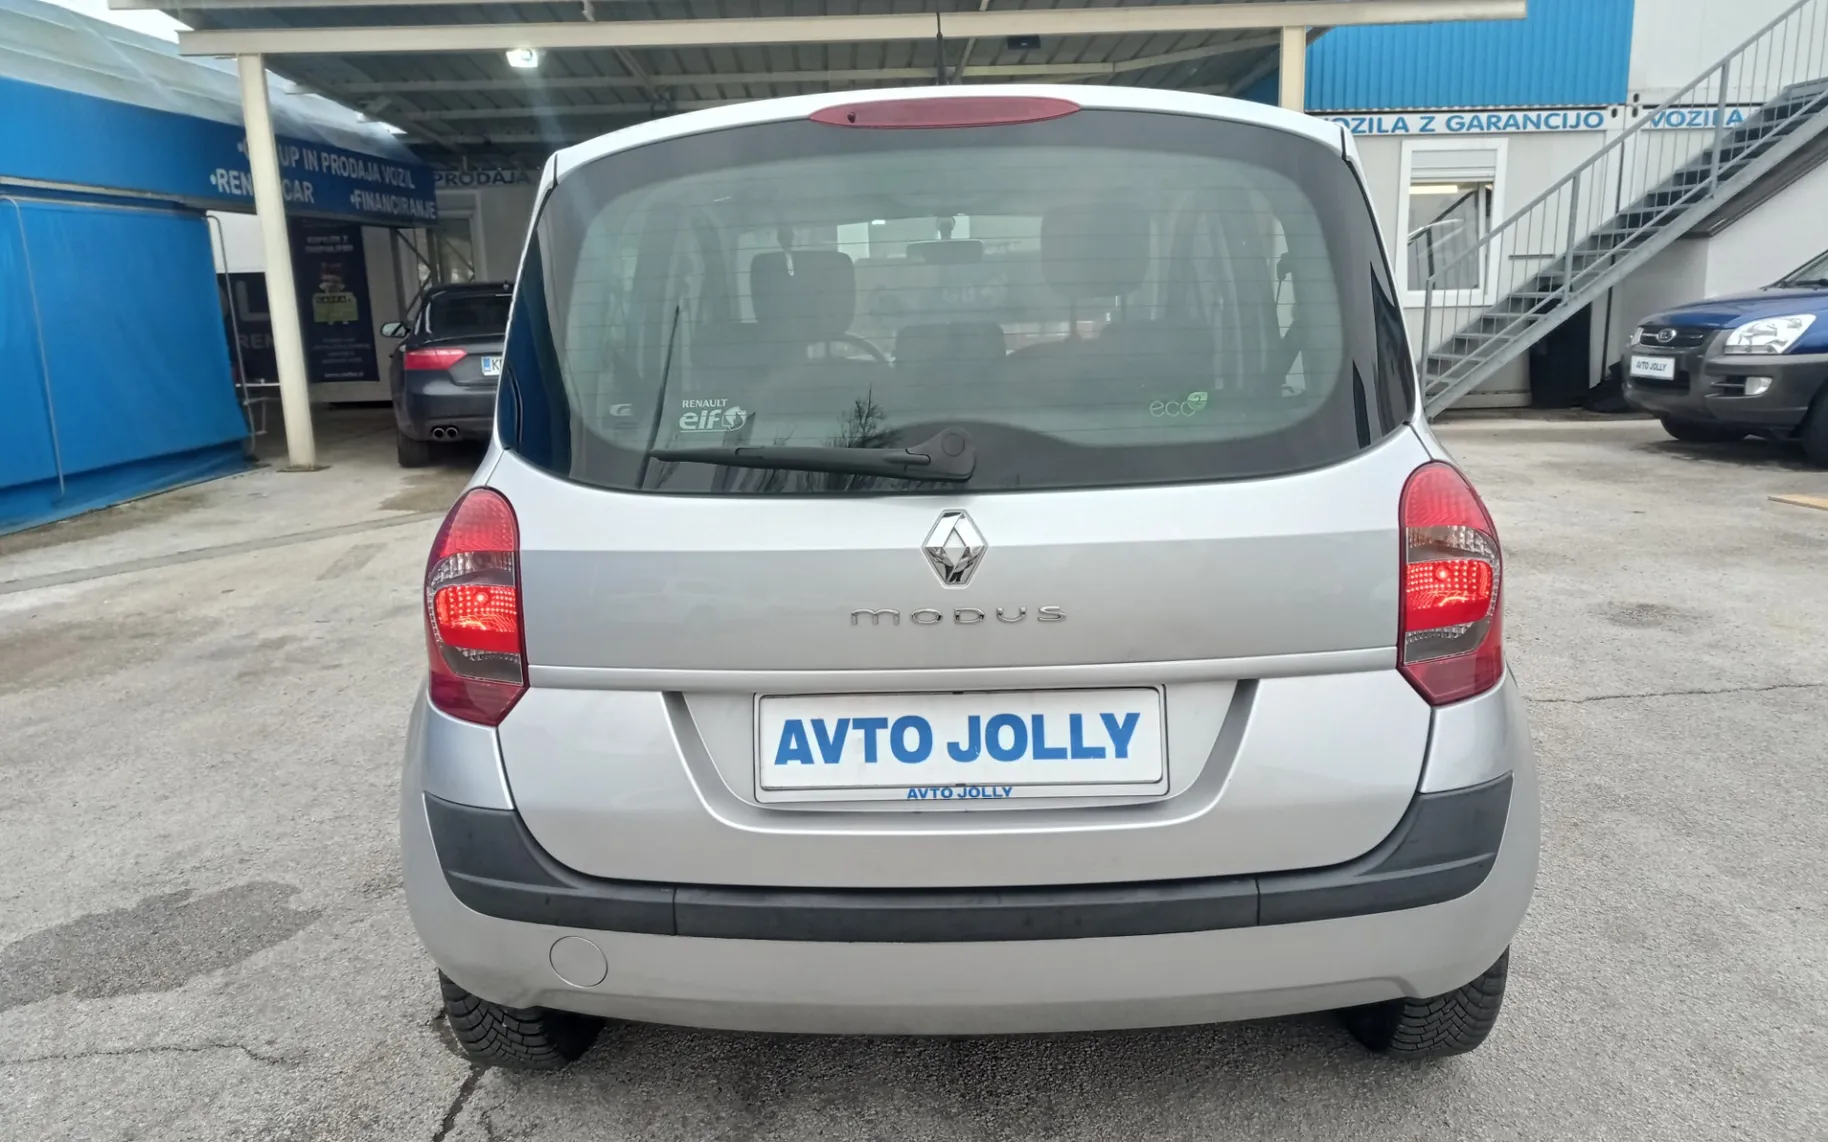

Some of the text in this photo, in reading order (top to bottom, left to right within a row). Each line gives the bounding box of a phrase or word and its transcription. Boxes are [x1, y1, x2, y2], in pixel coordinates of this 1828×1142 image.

[1324, 111, 1605, 134] OZILA Z GARANCIJO
[304, 148, 319, 173] IN
[321, 152, 381, 183] PRODAJA
[382, 164, 416, 189] VOZIL
[216, 168, 315, 204] REN CAR
[353, 189, 437, 219] FINANCIRANJE
[682, 399, 728, 408] RENAULT
[679, 409, 722, 430] elf
[850, 605, 1067, 626] MODUS
[774, 712, 1141, 765] AVTO JOLLY
[907, 786, 1013, 799] AVTO JOLLY
